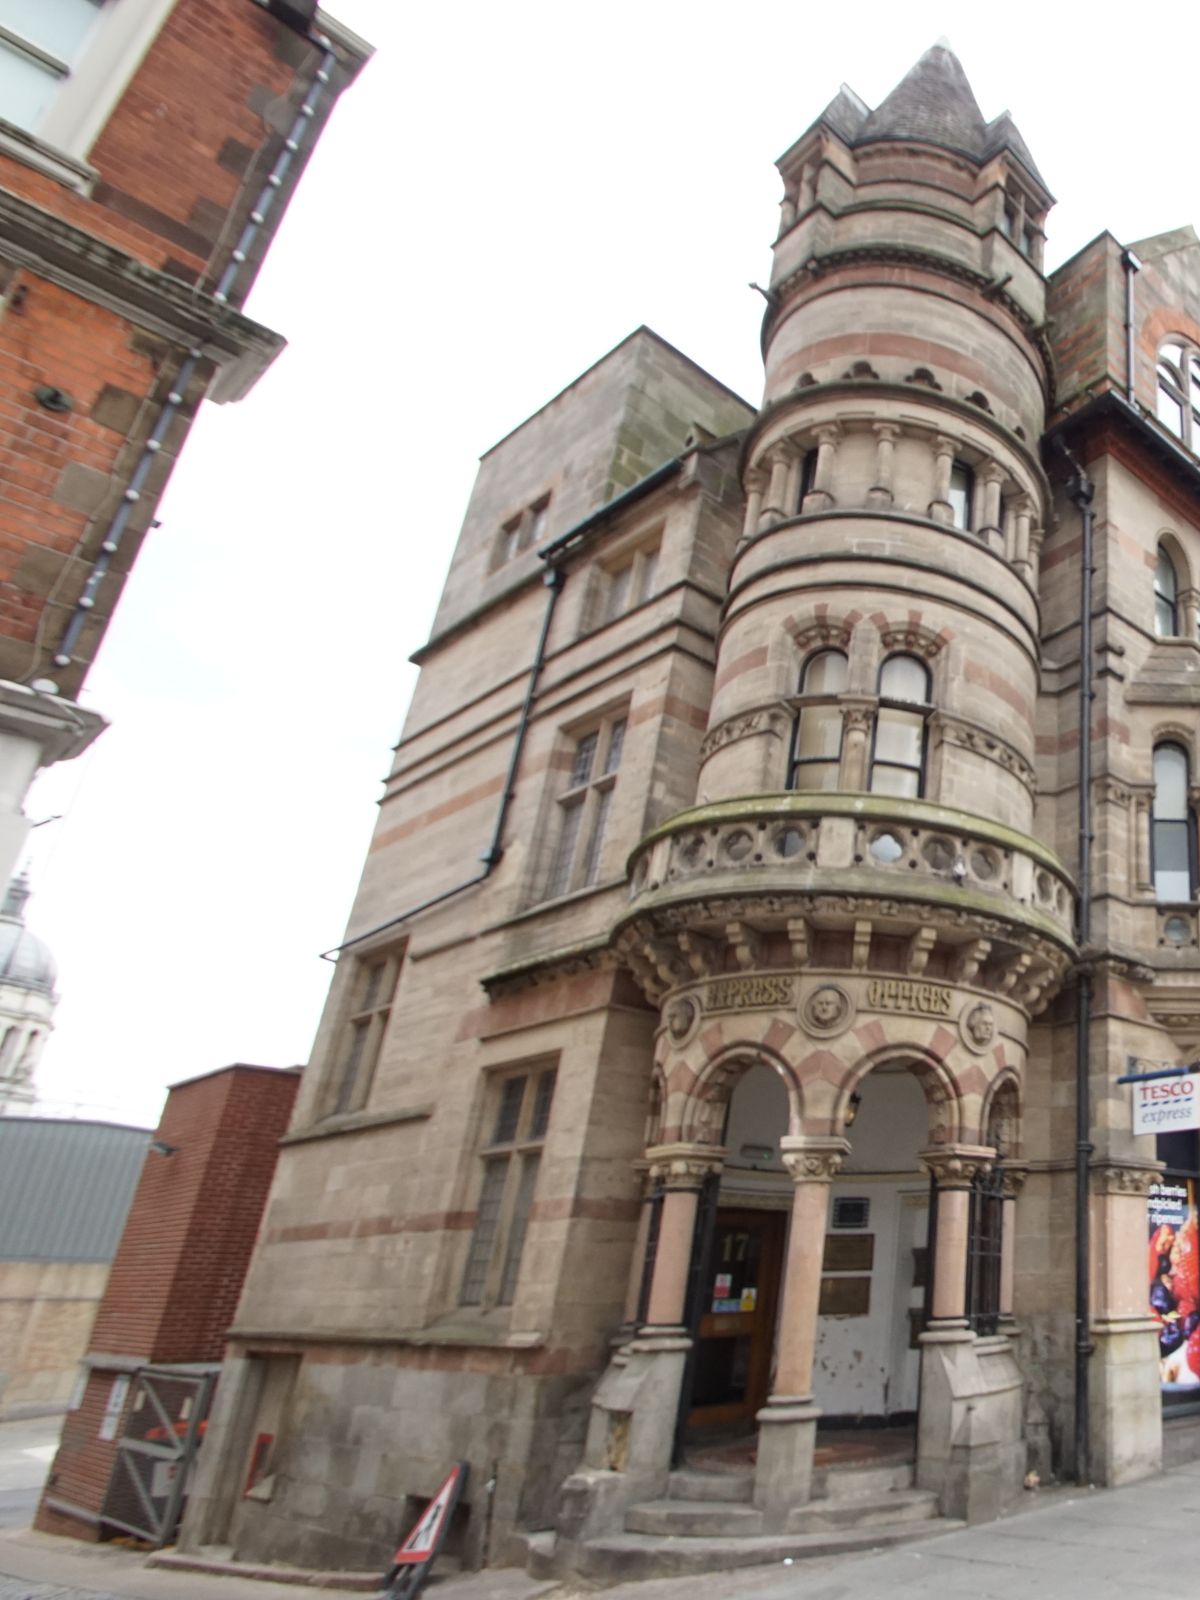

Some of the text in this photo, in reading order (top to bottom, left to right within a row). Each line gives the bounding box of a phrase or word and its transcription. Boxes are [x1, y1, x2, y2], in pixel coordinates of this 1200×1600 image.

[705, 975, 953, 1015] EXPRESS OFFICES
[1140, 1081, 1194, 1100] TESCO
[1141, 1107, 1193, 1124] express
[1160, 1184, 1188, 1197] berries
[719, 1233, 750, 1262] 17
